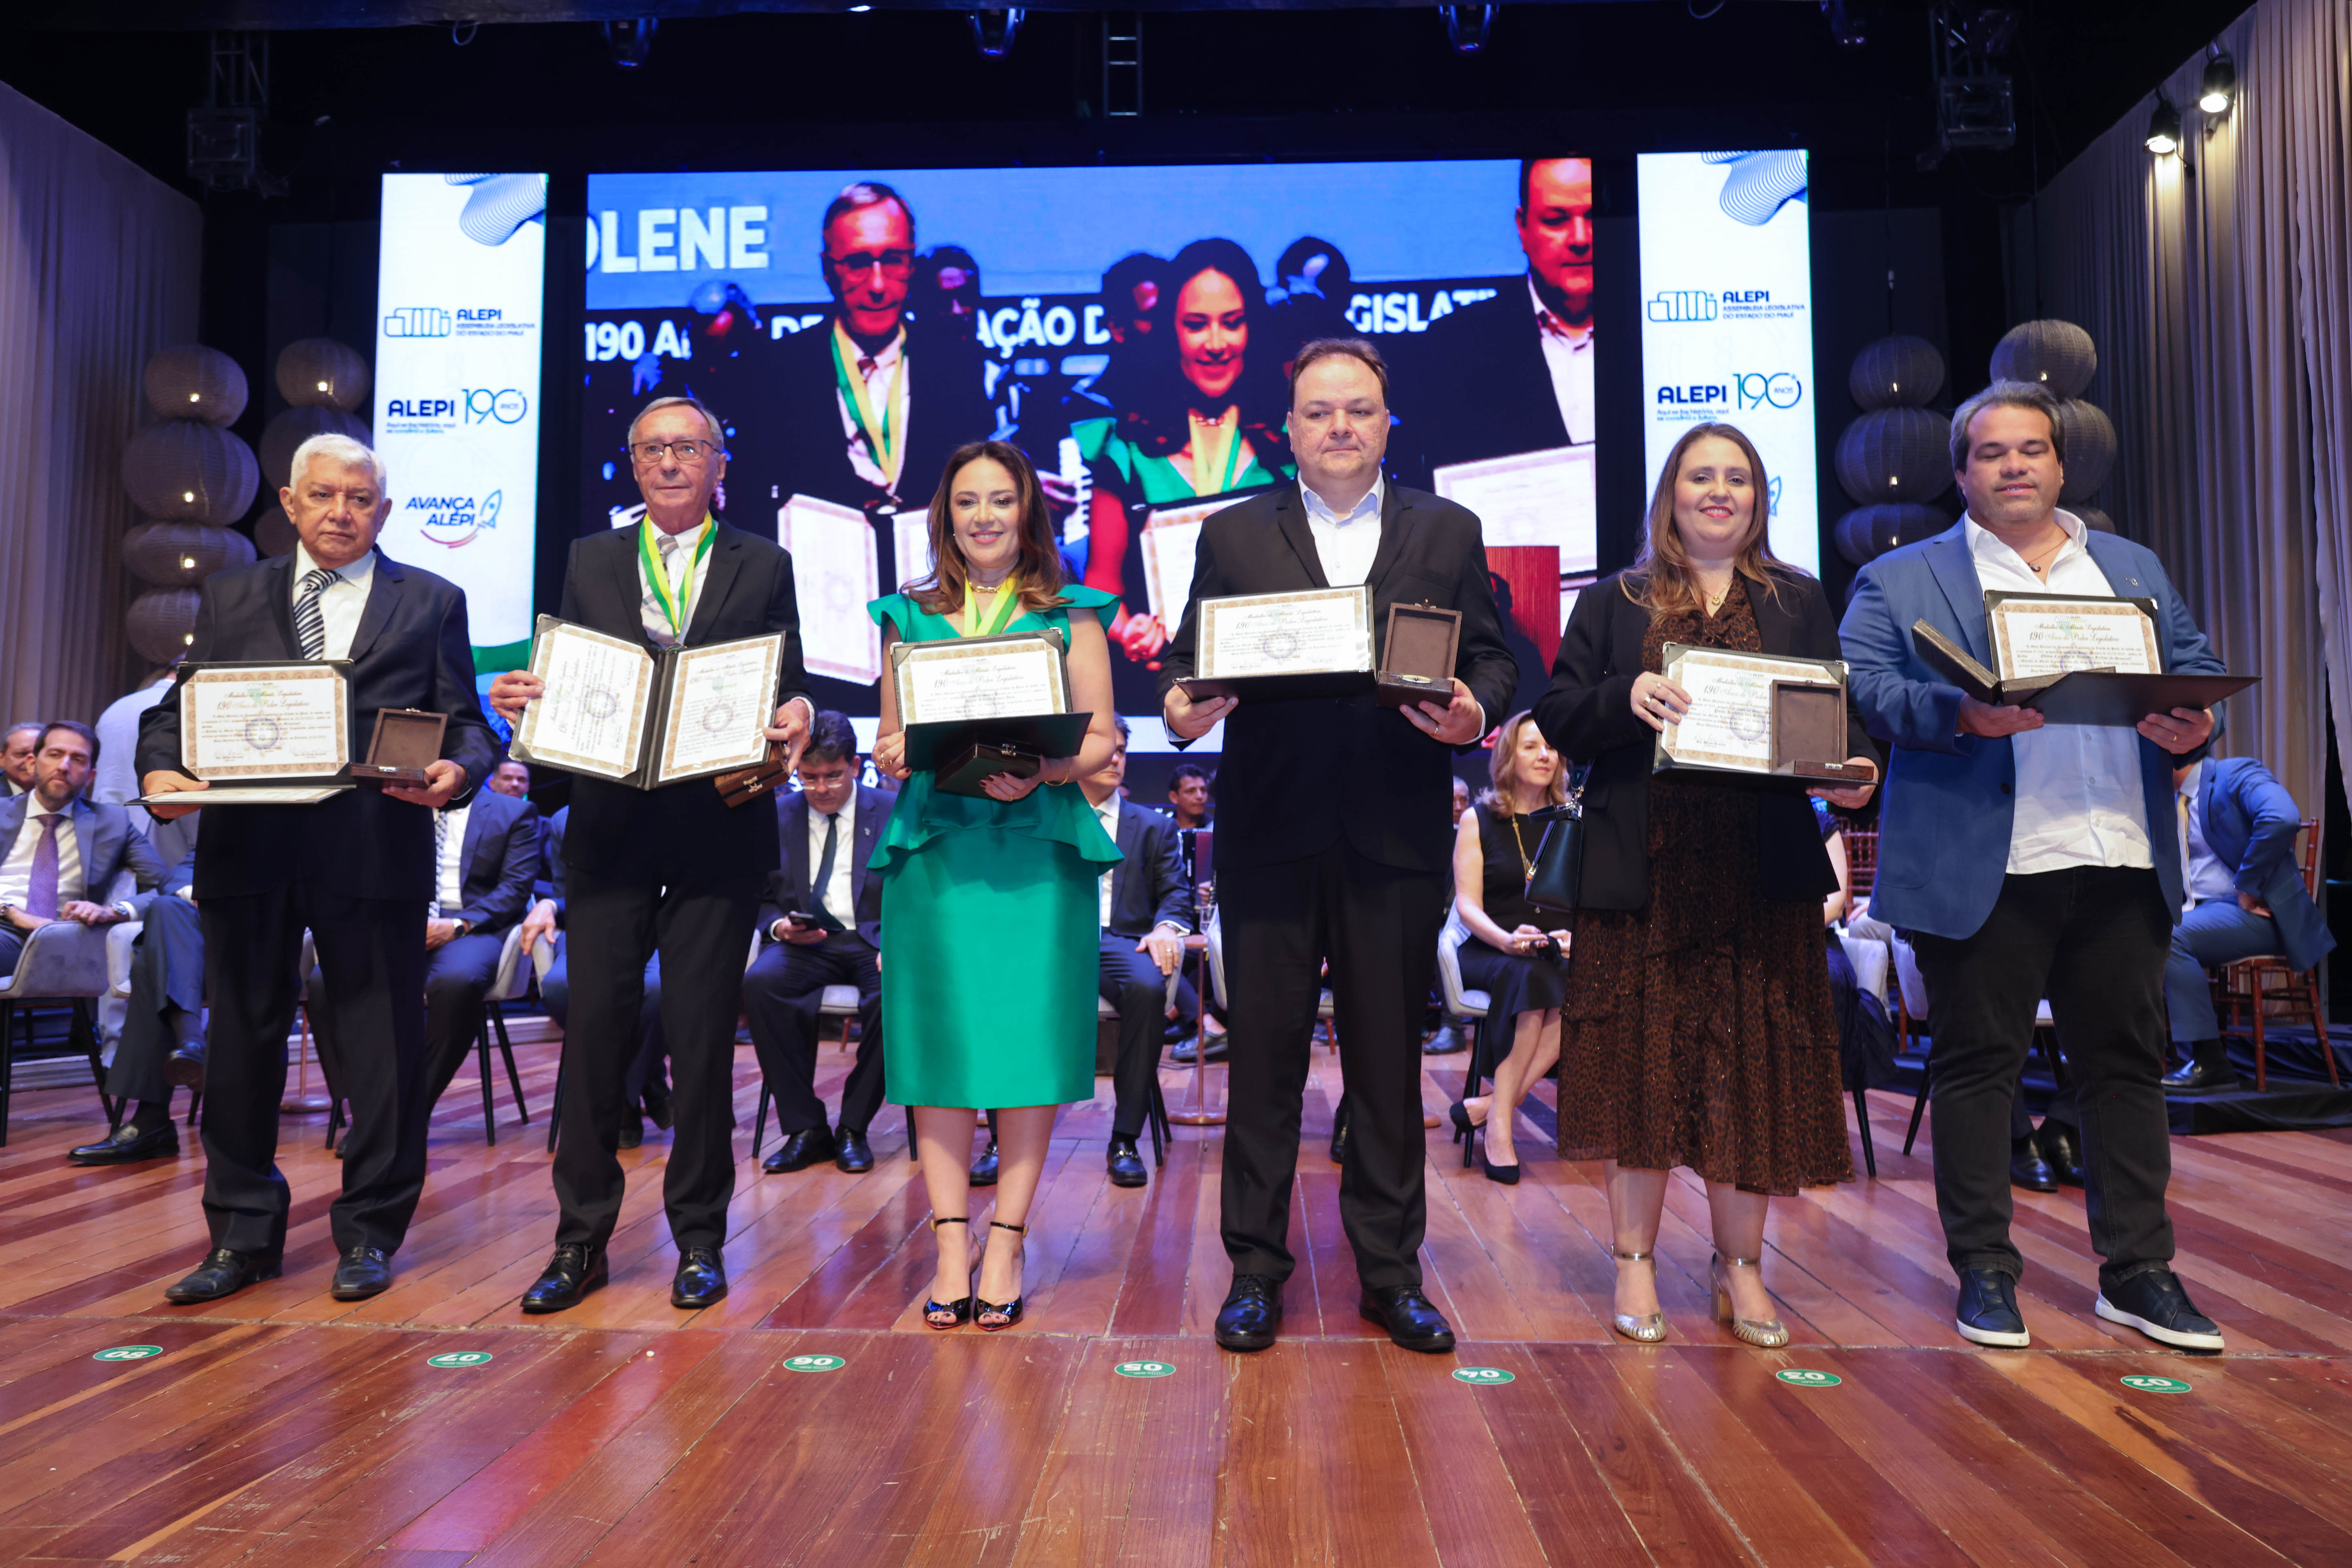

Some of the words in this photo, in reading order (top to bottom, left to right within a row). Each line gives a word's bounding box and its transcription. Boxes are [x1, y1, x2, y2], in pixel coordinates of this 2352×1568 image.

[1723, 291, 1769, 303] ALEPI
[456, 309, 502, 321] ALEPI
[585, 320, 646, 361] 190
[1657, 386, 1727, 404] ALEPI
[1733, 373, 1802, 410] 190
[389, 400, 454, 417] ALEPI
[461, 389, 528, 424] 190
[405, 497, 475, 513] AVANÇA
[426, 513, 476, 526] ALEPI
[2028, 631, 2043, 641] 190
[1703, 684, 1719, 694] 190
